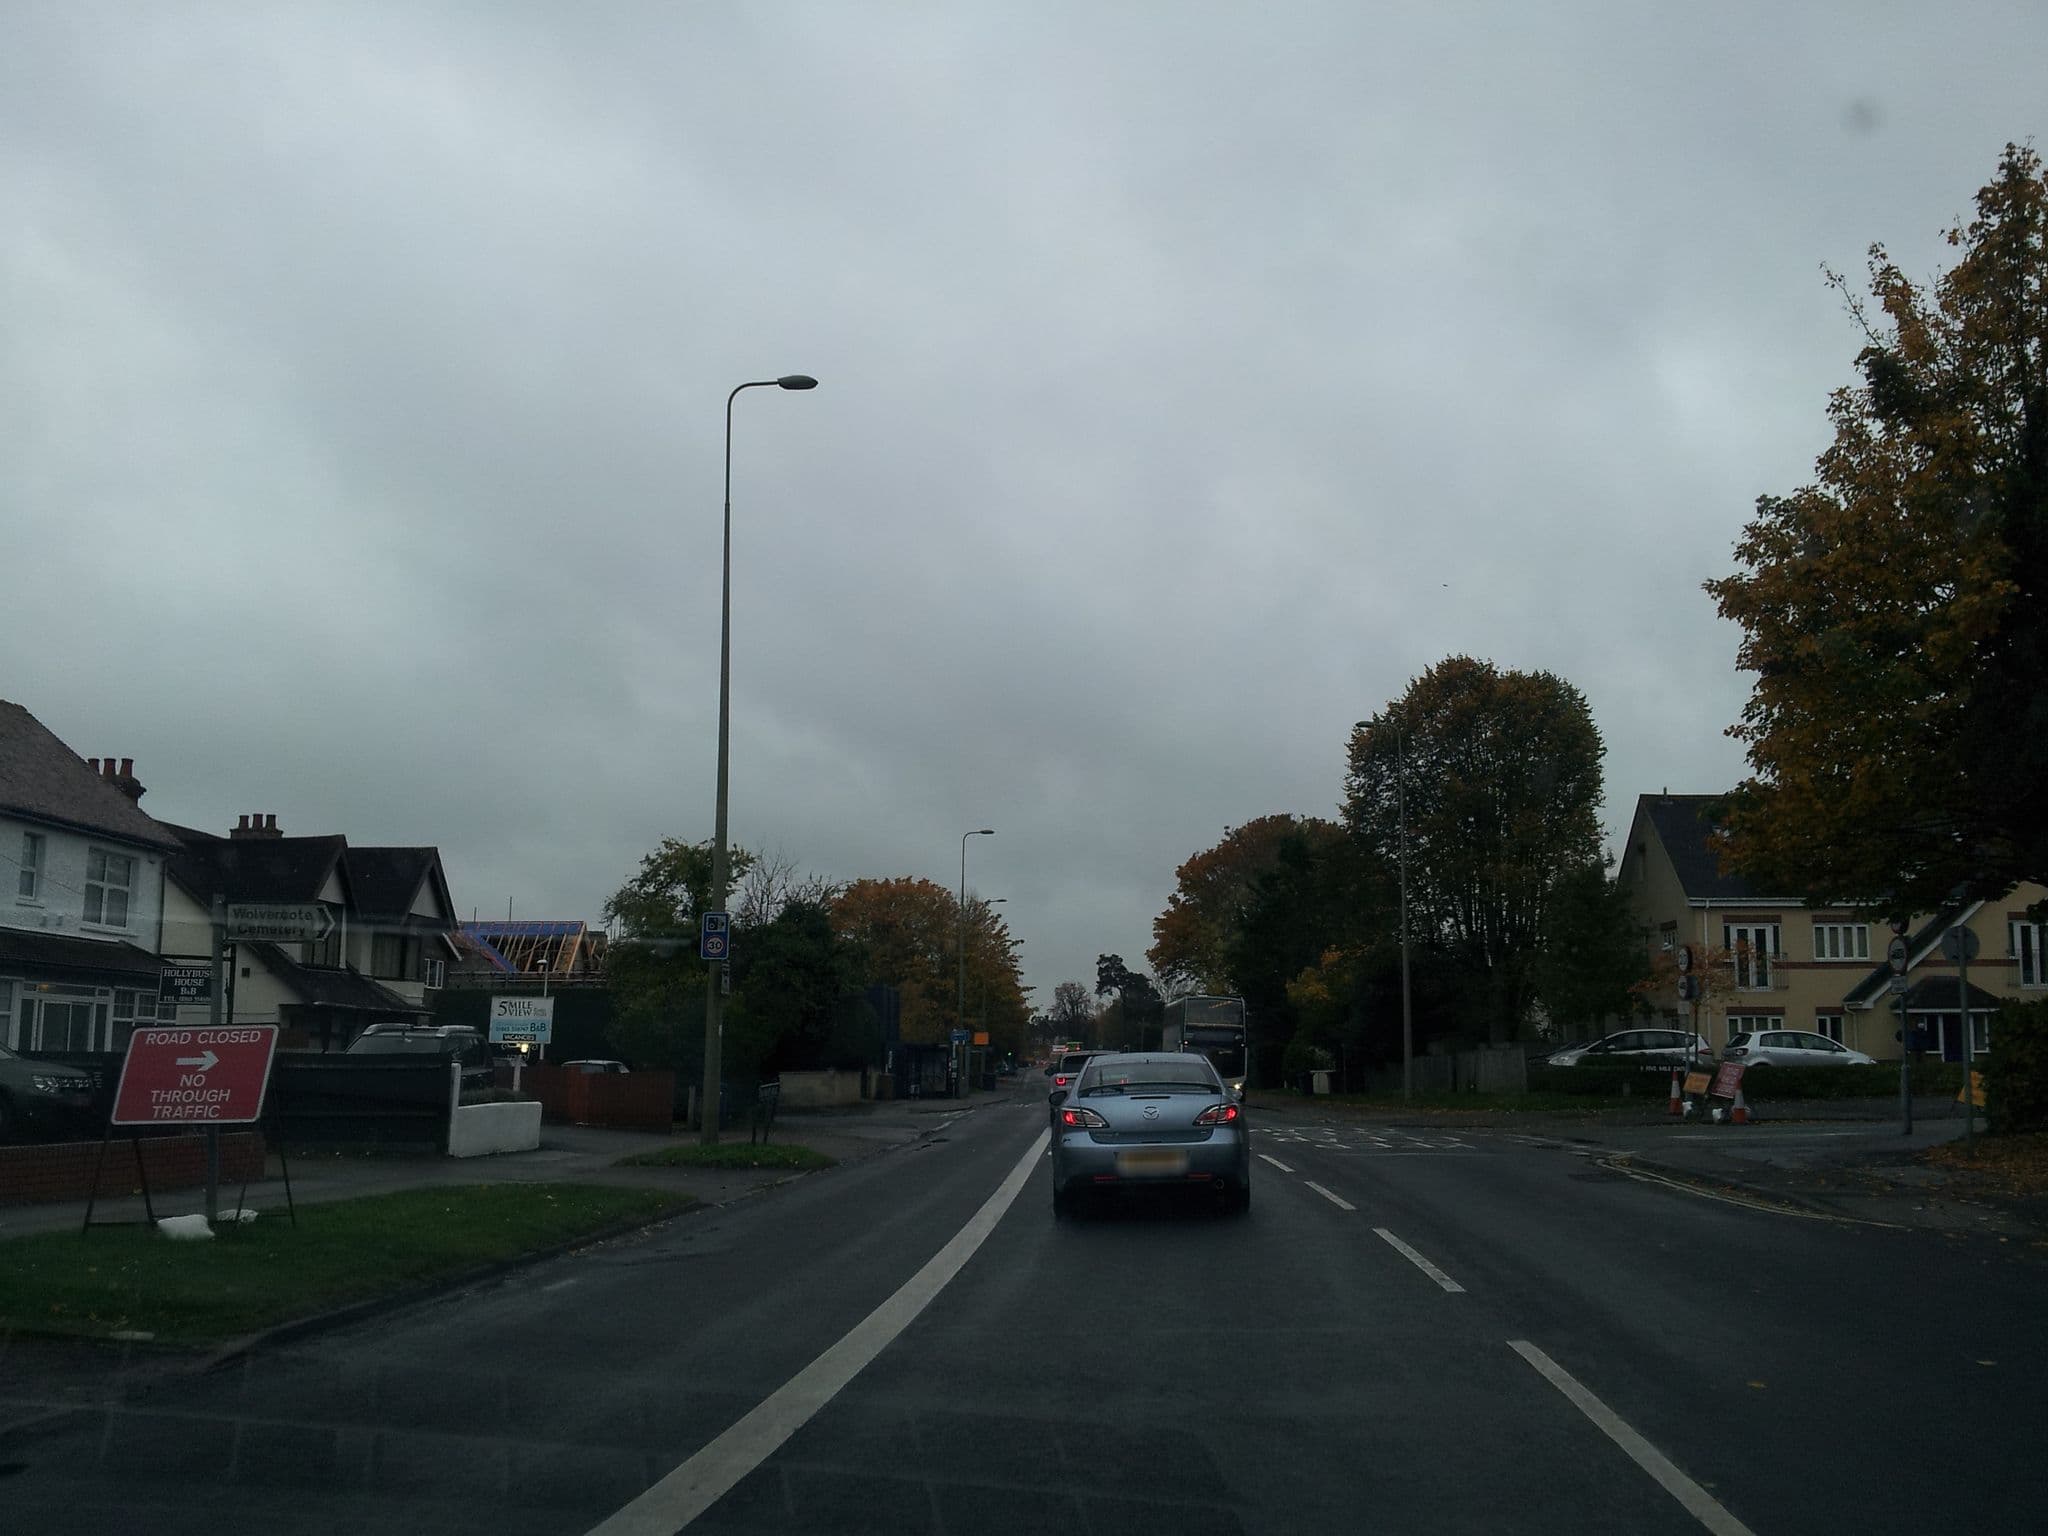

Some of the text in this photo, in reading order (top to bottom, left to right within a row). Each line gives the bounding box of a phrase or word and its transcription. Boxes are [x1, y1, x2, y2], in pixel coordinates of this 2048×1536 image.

[232, 908, 313, 921] Wolvercote
[239, 926, 305, 936] Cemetery
[708, 941, 722, 950] 30
[174, 978, 205, 987] HOUSE
[497, 1000, 533, 1016] 5 MILE
[508, 1008, 533, 1017] VIEW
[530, 1022, 546, 1032] B&B
[145, 1030, 261, 1045] ROAD CLOSED
[179, 1074, 206, 1087] NO
[151, 1089, 231, 1103] THROUGH
[152, 1105, 221, 1119] TRAFFIC
